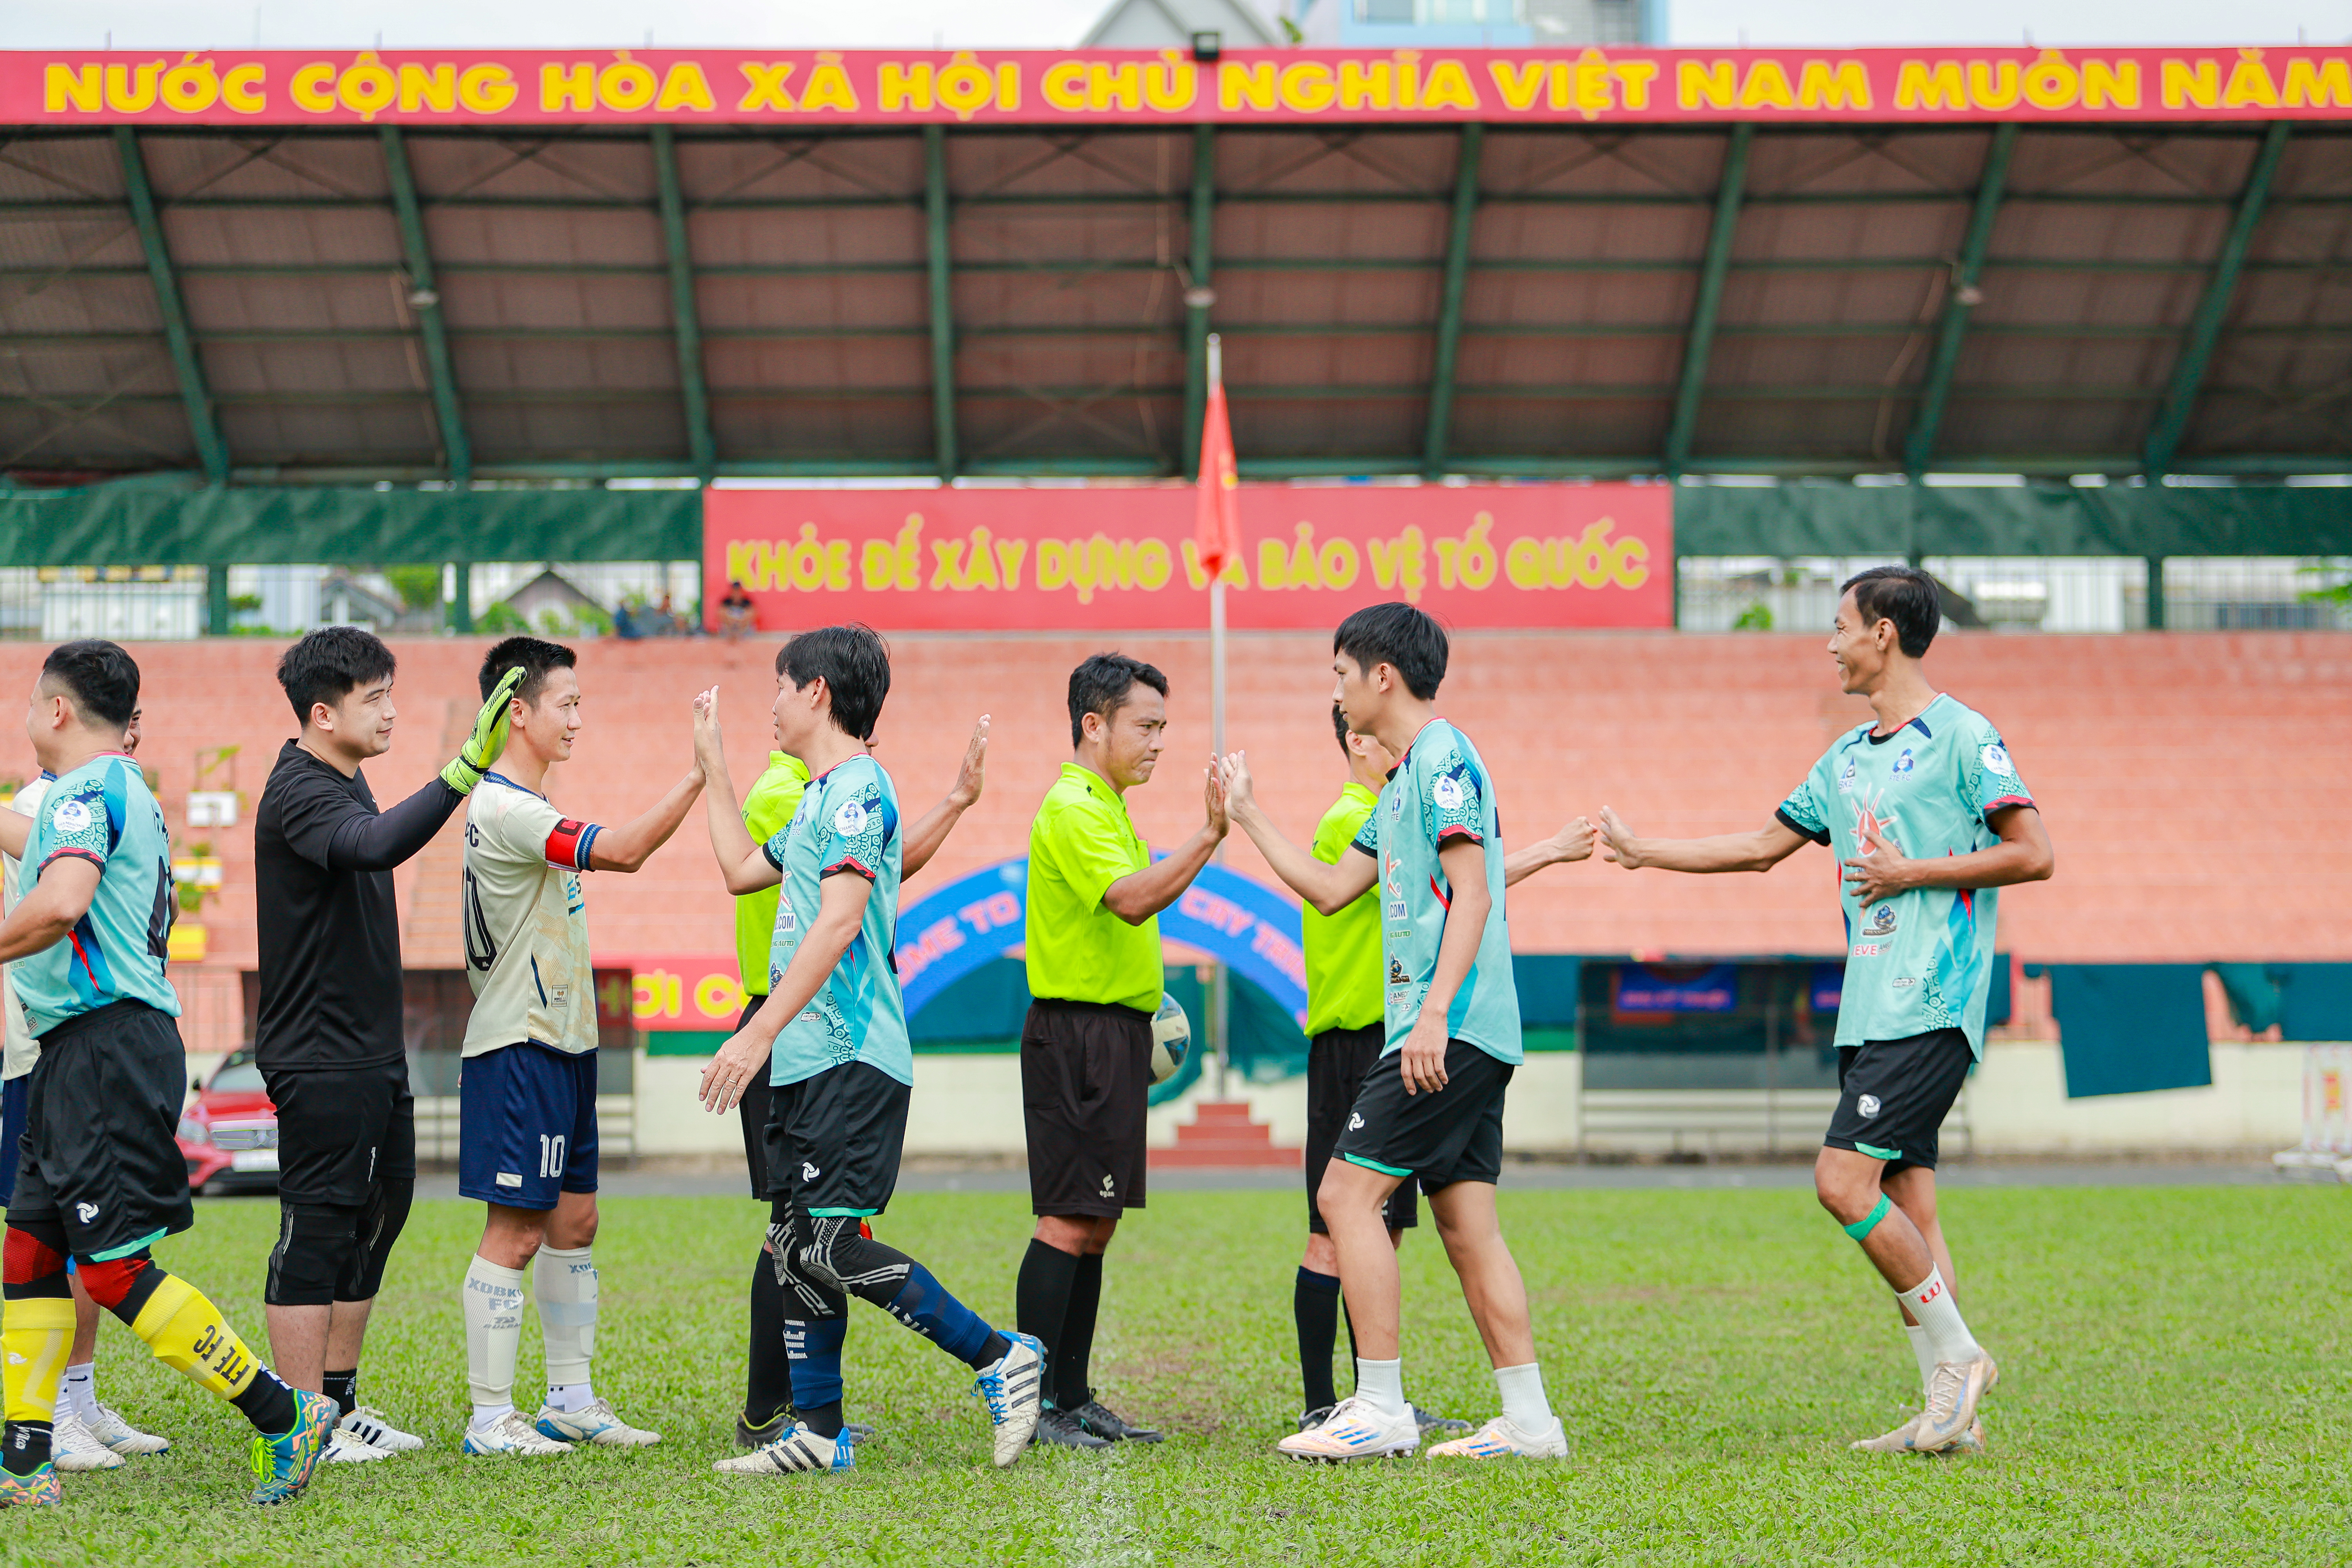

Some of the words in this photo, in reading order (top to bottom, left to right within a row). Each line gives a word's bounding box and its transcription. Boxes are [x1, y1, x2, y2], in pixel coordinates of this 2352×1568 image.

[45, 51, 266, 114] NƯỚC
[290, 51, 518, 121] CỘNG
[540, 50, 715, 112] HÒA
[739, 53, 859, 112] XÃ
[878, 50, 1020, 121] HỘI
[1042, 49, 1197, 112] CHỦ
[1218, 50, 1479, 113] NGHĨA
[1489, 49, 1658, 120] VIỆT
[1677, 60, 1872, 110] NAM
[1894, 48, 2141, 110] MUÔN
[2161, 48, 2352, 109] NĂM
[728, 524, 849, 590] KHỎE
[861, 514, 920, 589] ĐỂ
[933, 528, 1025, 588] XÂY
[1038, 534, 1170, 602] DỰNG
[1260, 524, 1357, 589] BẢO
[1368, 527, 1424, 601] VỆ
[1435, 514, 1496, 589] TỔ
[1506, 518, 1646, 589] QUỐC
[540, 1134, 565, 1178] 10
[193, 1324, 225, 1362] FC
[213, 1345, 251, 1387] FTE
